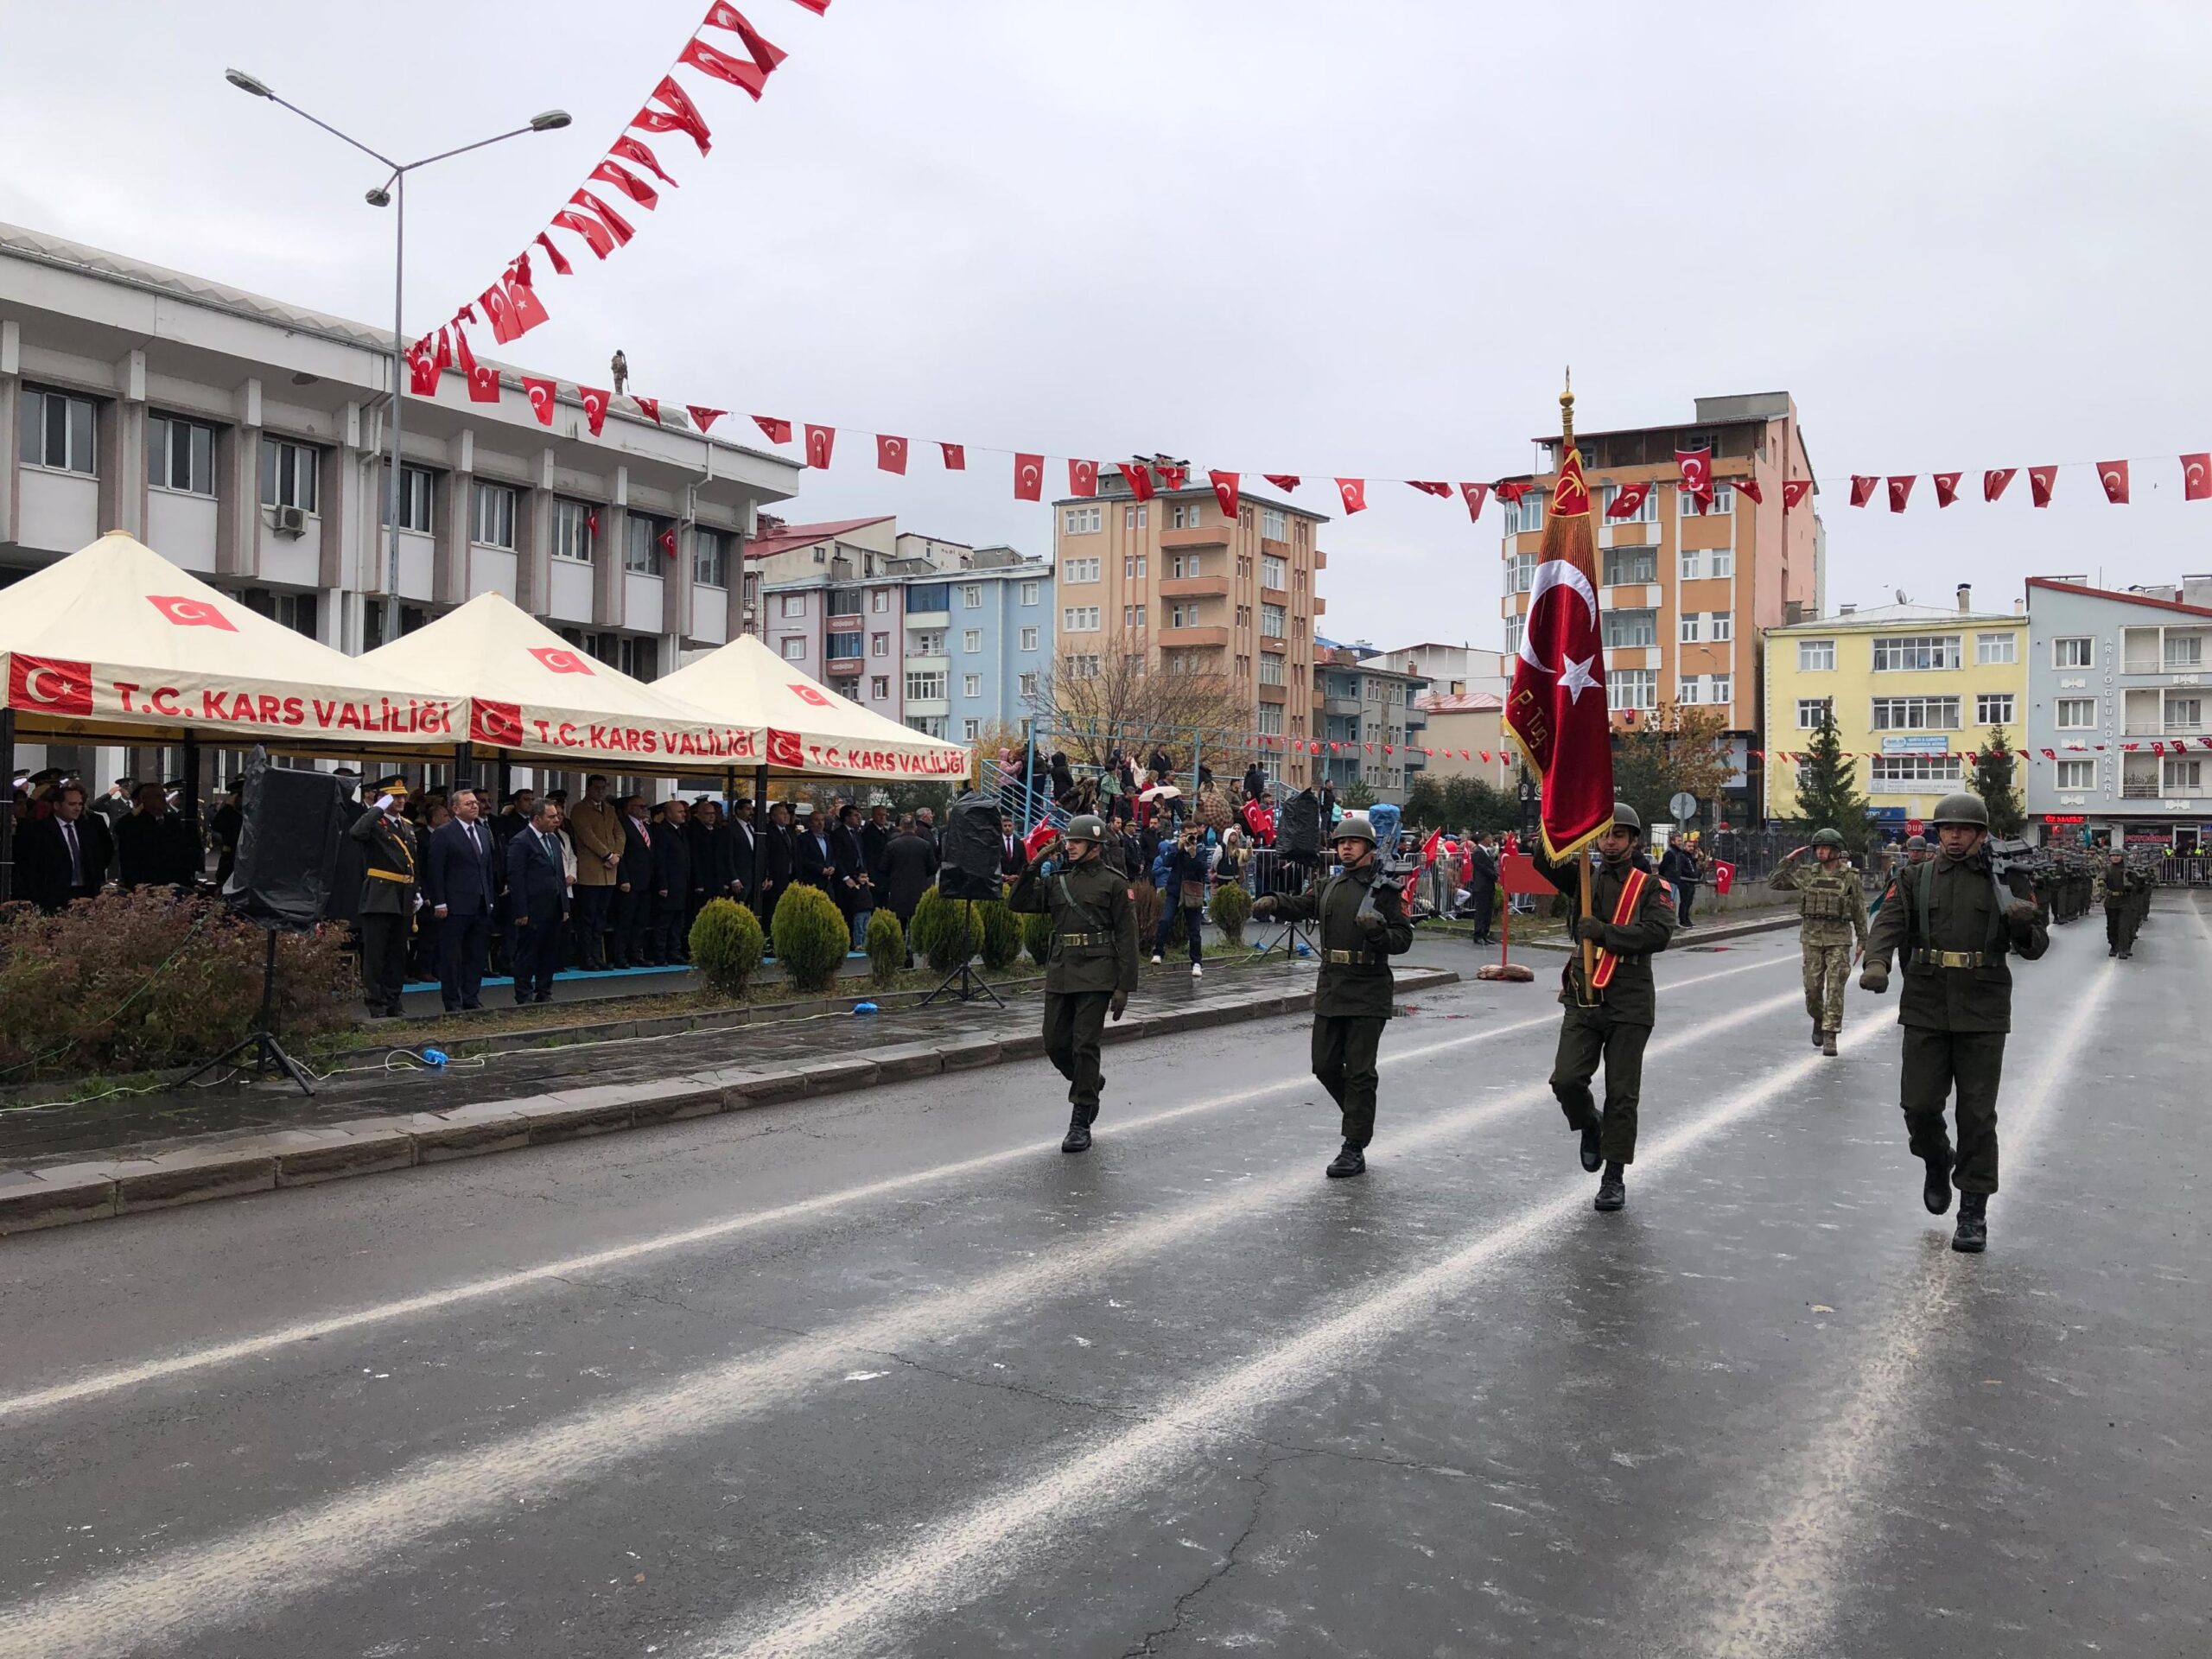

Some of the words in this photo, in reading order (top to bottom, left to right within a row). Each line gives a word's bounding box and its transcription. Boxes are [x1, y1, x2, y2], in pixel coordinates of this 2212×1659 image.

[113, 682, 194, 717] T.C.
[202, 690, 305, 728] KARS
[312, 696, 452, 734] VALİLİĞİ
[533, 719, 586, 749] T.C.
[590, 725, 658, 754] KARS
[662, 728, 755, 759] VALİLİĞİ
[809, 745, 846, 769] T.C.
[848, 750, 898, 772] KARS
[899, 749, 965, 775] VALİLİĞİ
